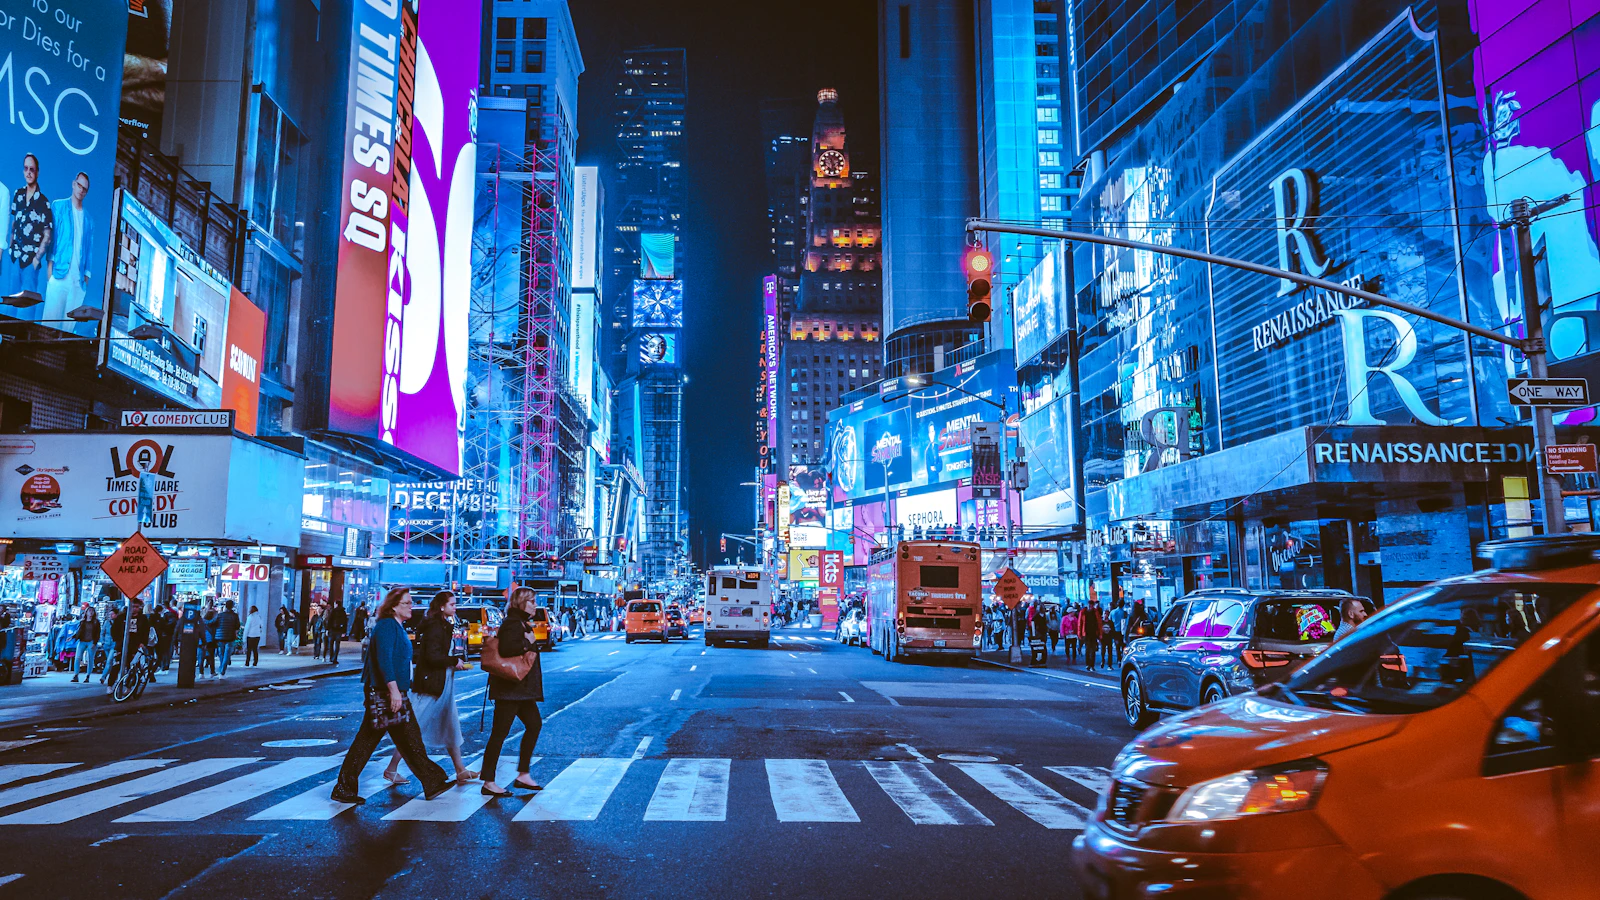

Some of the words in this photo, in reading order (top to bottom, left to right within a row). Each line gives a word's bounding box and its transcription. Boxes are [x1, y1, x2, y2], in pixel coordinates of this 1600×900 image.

[55, 9, 82, 33] our
[23, 16, 60, 56] Dies
[67, 41, 90, 72] for
[95, 65, 105, 81] a
[353, 22, 397, 175] TIMES
[343, 178, 388, 253] SQ
[1269, 168, 1334, 298] R
[1251, 274, 1365, 353] RENAISSANCE
[768, 314, 777, 368] AMERICA'S
[759, 330, 767, 394] ERNST
[1333, 309, 1467, 426] R
[770, 370, 778, 420] NETWORK
[1519, 387, 1542, 397] ONE
[1555, 387, 1580, 397] WAY
[946, 412, 984, 432] MENTAL
[876, 435, 902, 449] MENTAL
[1315, 442, 1490, 464] RENAISSANCE
[973, 475, 1001, 485] RISE
[974, 466, 999, 476] ALL
[106, 477, 137, 492] TIMES
[154, 480, 180, 492] UARE
[109, 494, 177, 516] CODY
[908, 510, 943, 525] SEPHORA
[118, 565, 148, 573] AHEAD
[122, 556, 145, 564] WORK
[824, 553, 840, 584] tkts
[24, 572, 34, 580] 4
[43, 573, 60, 581] 10
[222, 563, 242, 579] 4
[245, 564, 268, 580] 10
[188, 610, 194, 619] P
